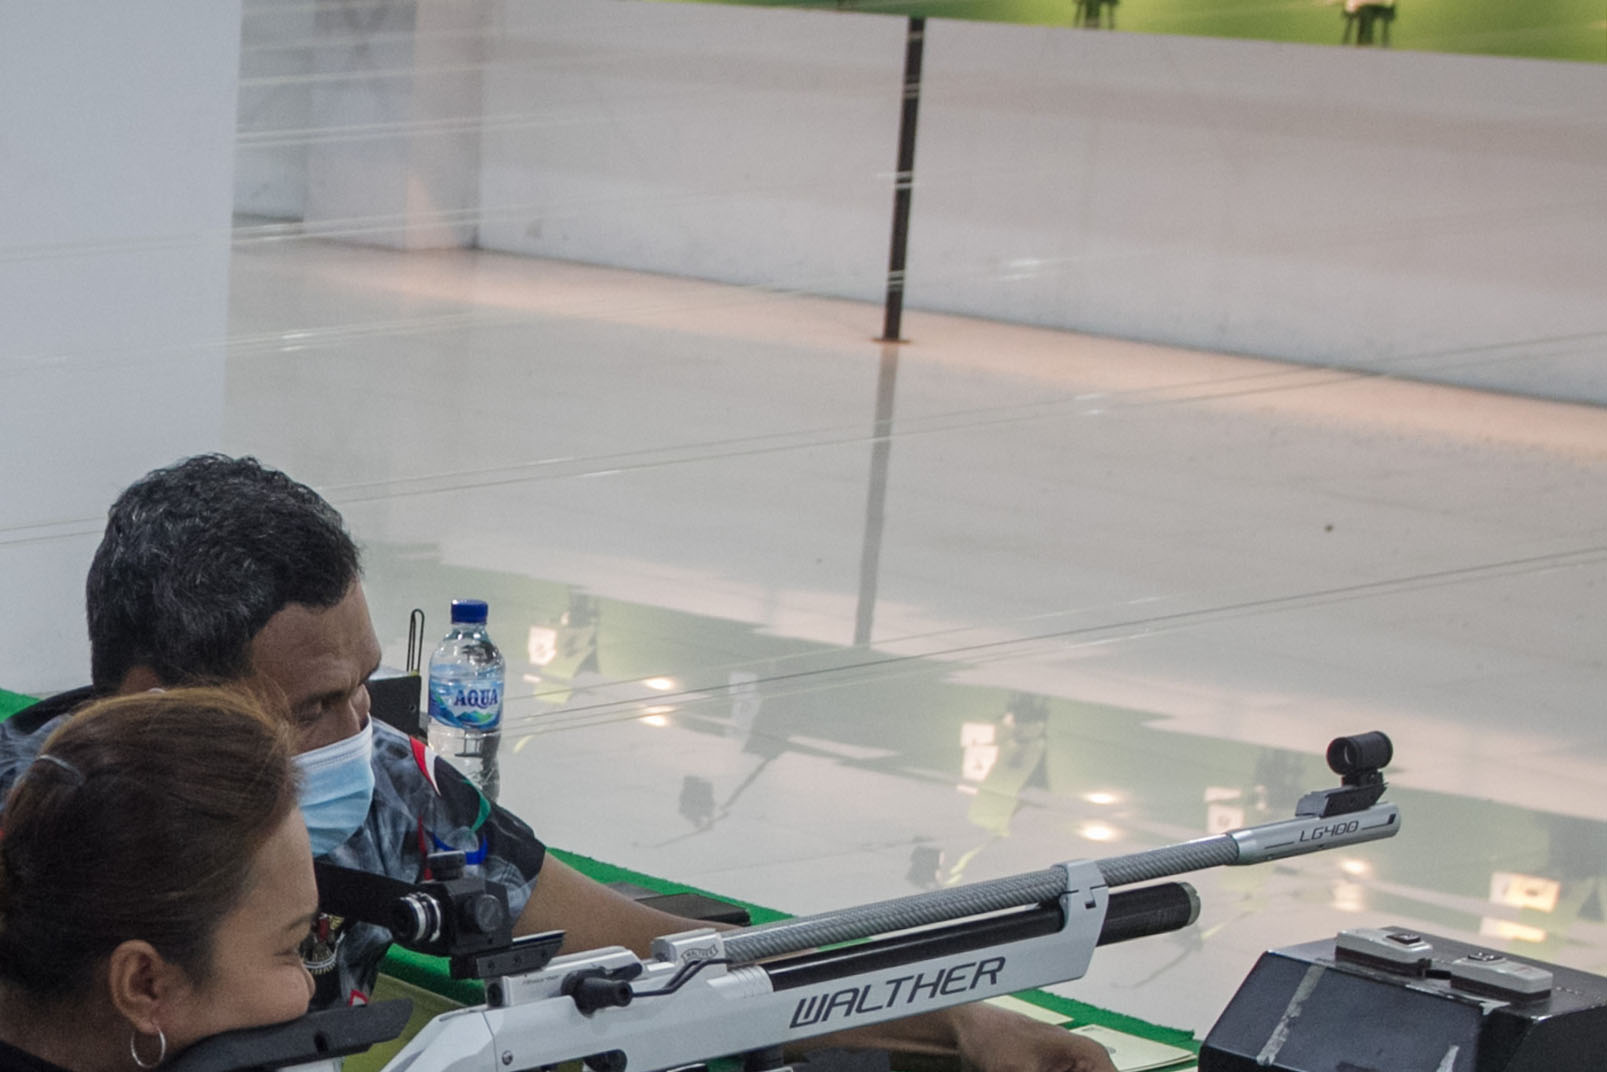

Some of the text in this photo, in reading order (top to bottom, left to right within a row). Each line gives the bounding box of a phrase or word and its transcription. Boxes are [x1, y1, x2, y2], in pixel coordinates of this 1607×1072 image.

[454, 688, 498, 710] AQUA
[1299, 820, 1359, 842] LG400
[789, 956, 1006, 1029] WALTHER
